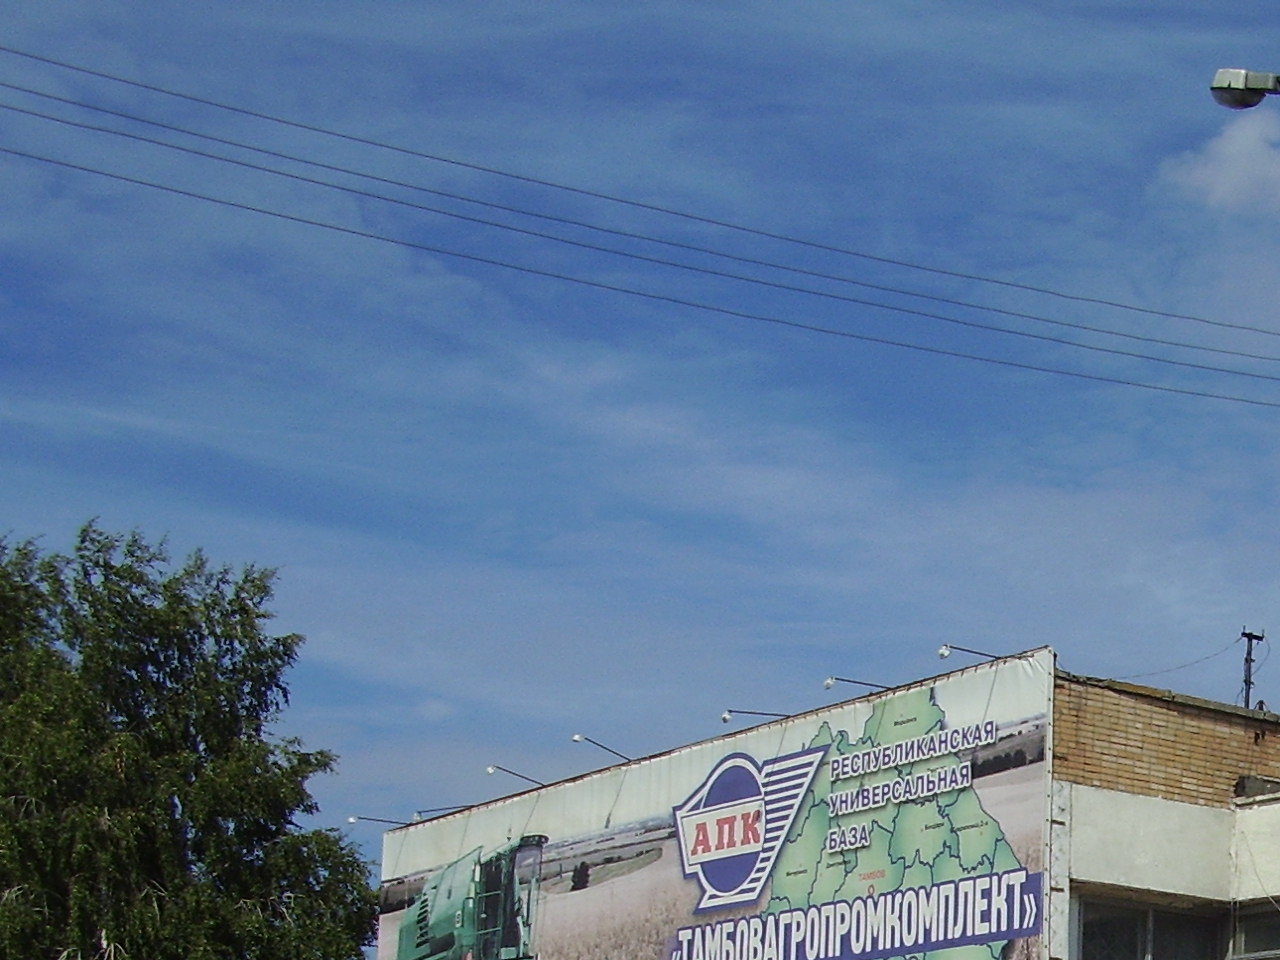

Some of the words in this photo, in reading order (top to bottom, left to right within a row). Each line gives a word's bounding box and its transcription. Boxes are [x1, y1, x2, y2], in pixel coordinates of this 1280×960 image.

[830, 720, 996, 780] РЕСПУБЛИКАНСКАЯ
[829, 763, 971, 817] УНИВЕРСАЛЬНАЯ
[691, 809, 762, 856] АПК
[827, 824, 869, 853] БАЗА
